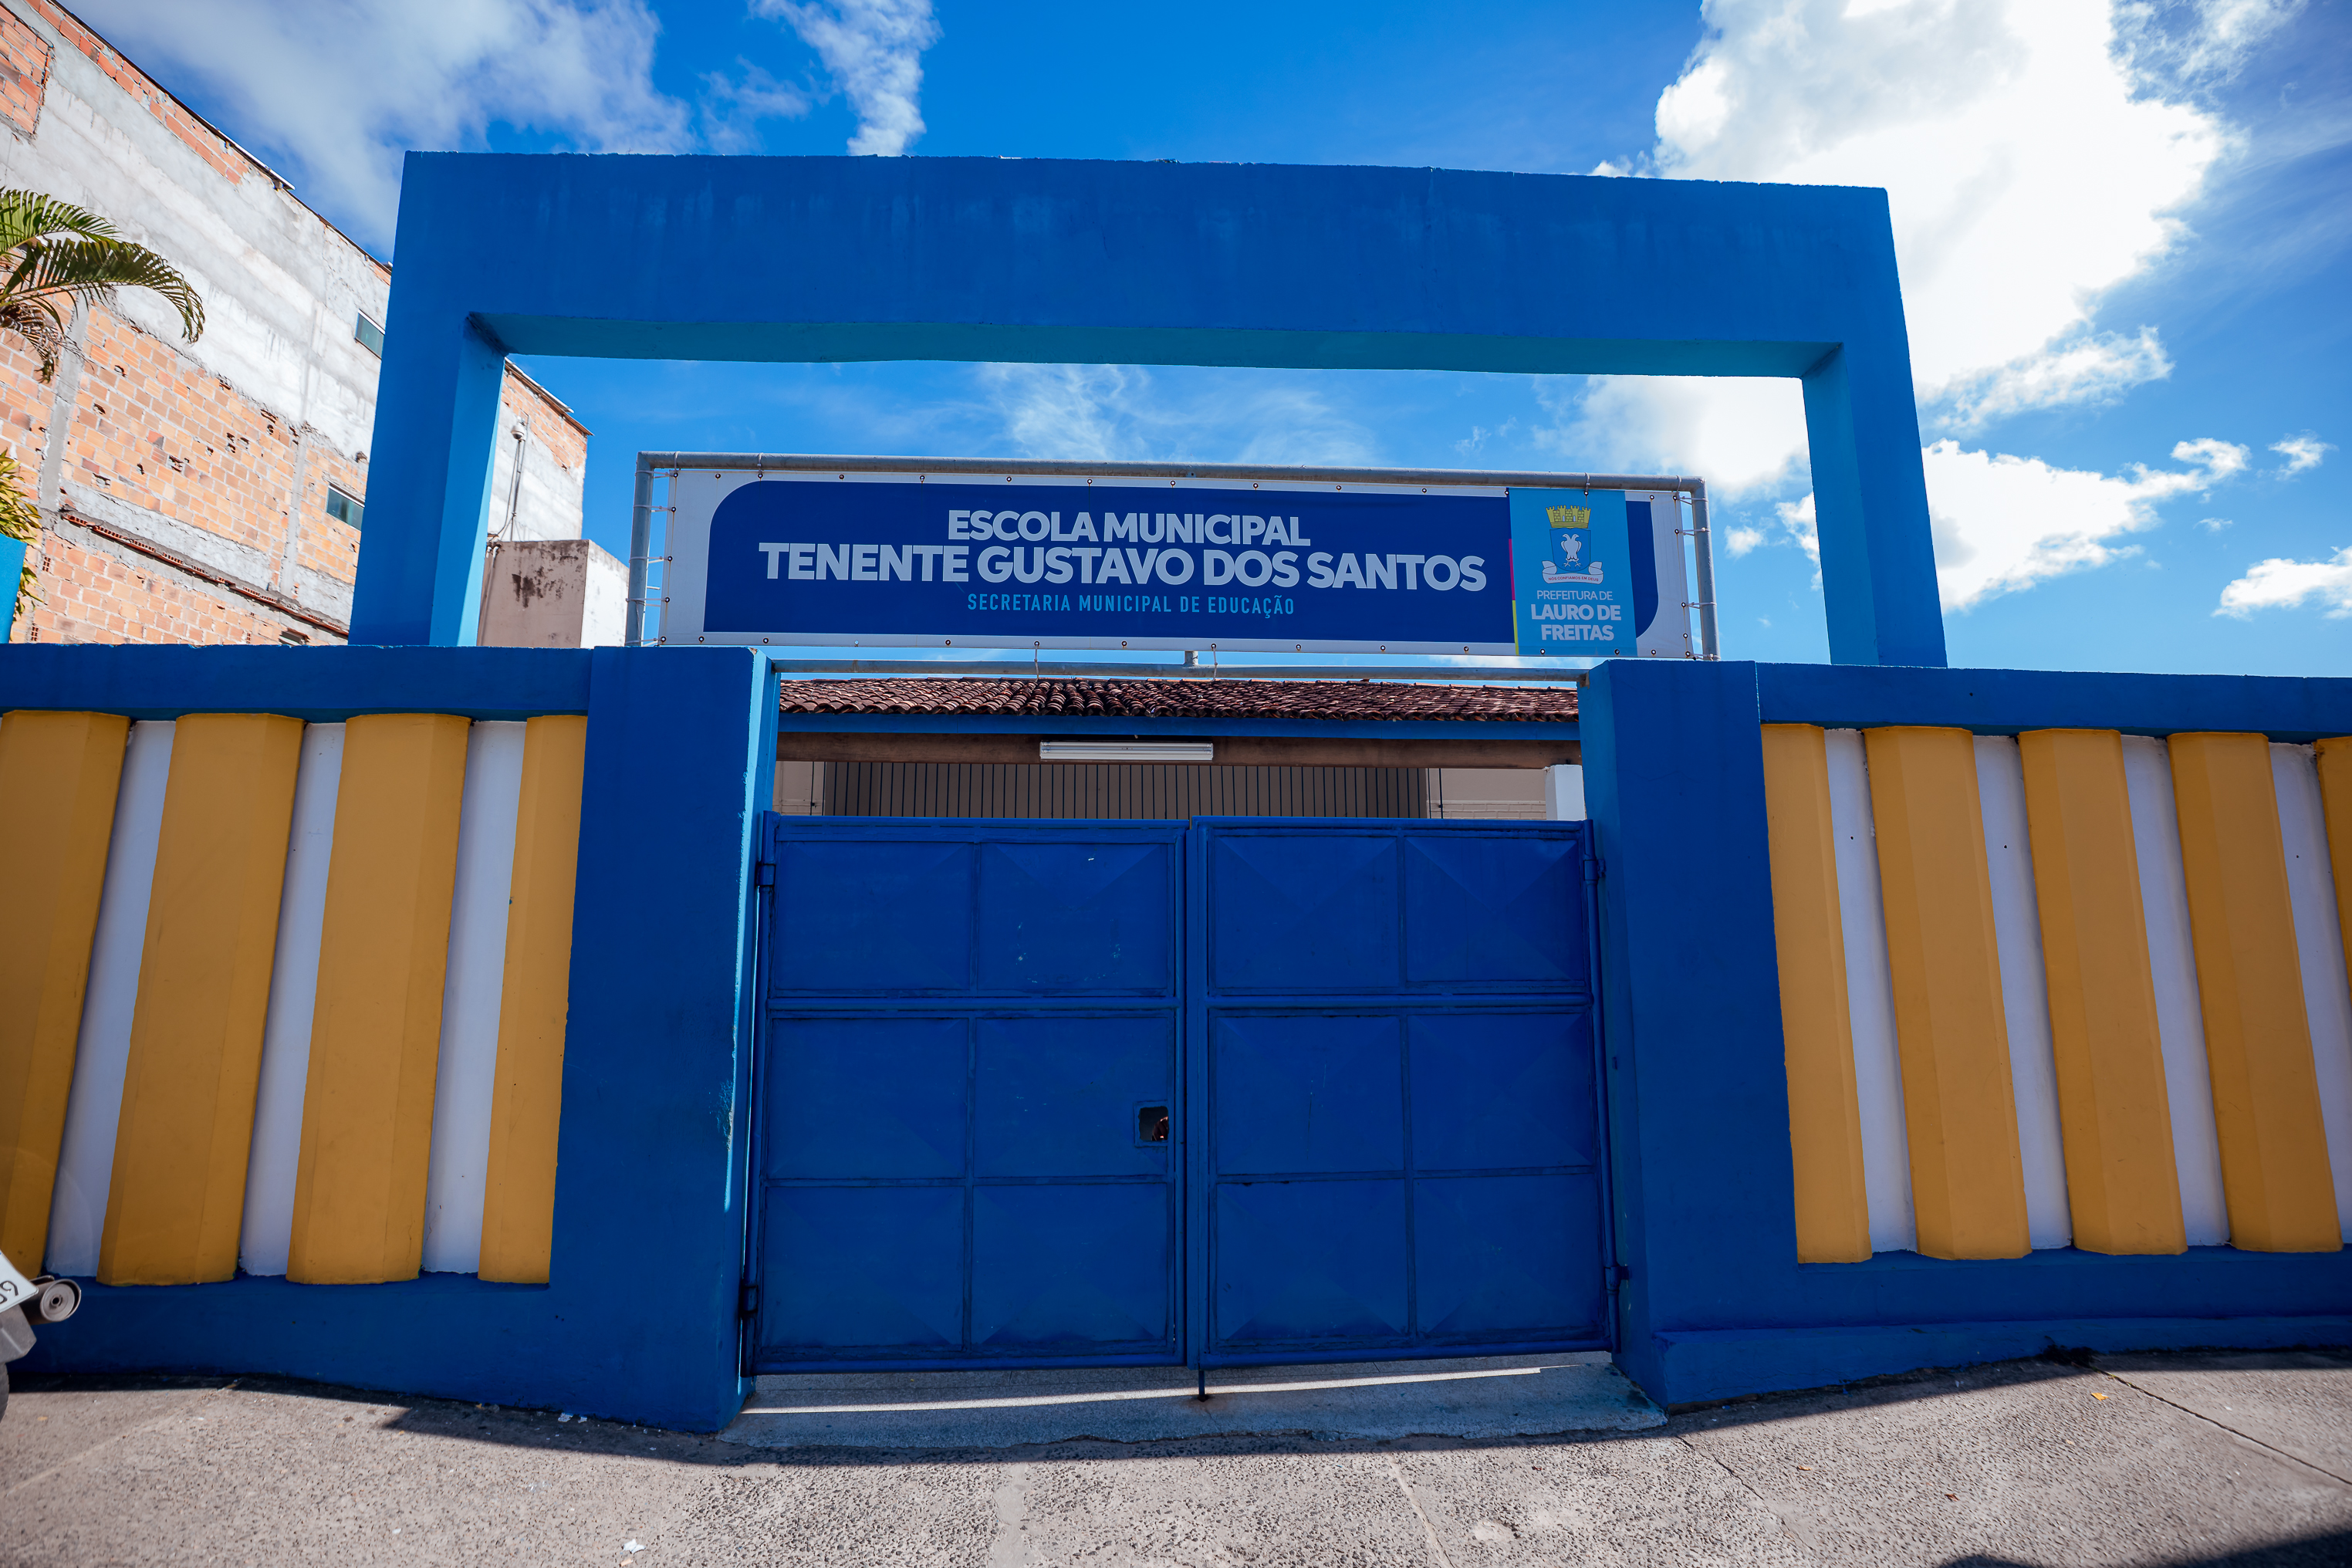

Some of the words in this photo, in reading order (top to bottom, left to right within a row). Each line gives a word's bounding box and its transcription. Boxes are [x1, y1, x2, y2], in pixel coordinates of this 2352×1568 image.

[948, 510, 1099, 542] ESCOLA
[1103, 512, 1311, 546] MUNICIPAL
[759, 542, 969, 582] TENENTE
[977, 546, 1195, 585] GUSTAVO
[1204, 549, 1300, 588] DOS
[1307, 552, 1487, 592] SANTOS
[1536, 590, 1598, 600] PREFEITURA
[1599, 591, 1614, 600] DE
[968, 593, 1070, 611] SECRETARIA
[1079, 595, 1171, 612] MUNICIPAL
[1180, 596, 1200, 613] DE
[1208, 595, 1294, 619] EDUCAÇÃO
[1531, 604, 1594, 620] LAURO
[1597, 605, 1622, 620] DE
[1541, 624, 1615, 640] FREITAS
